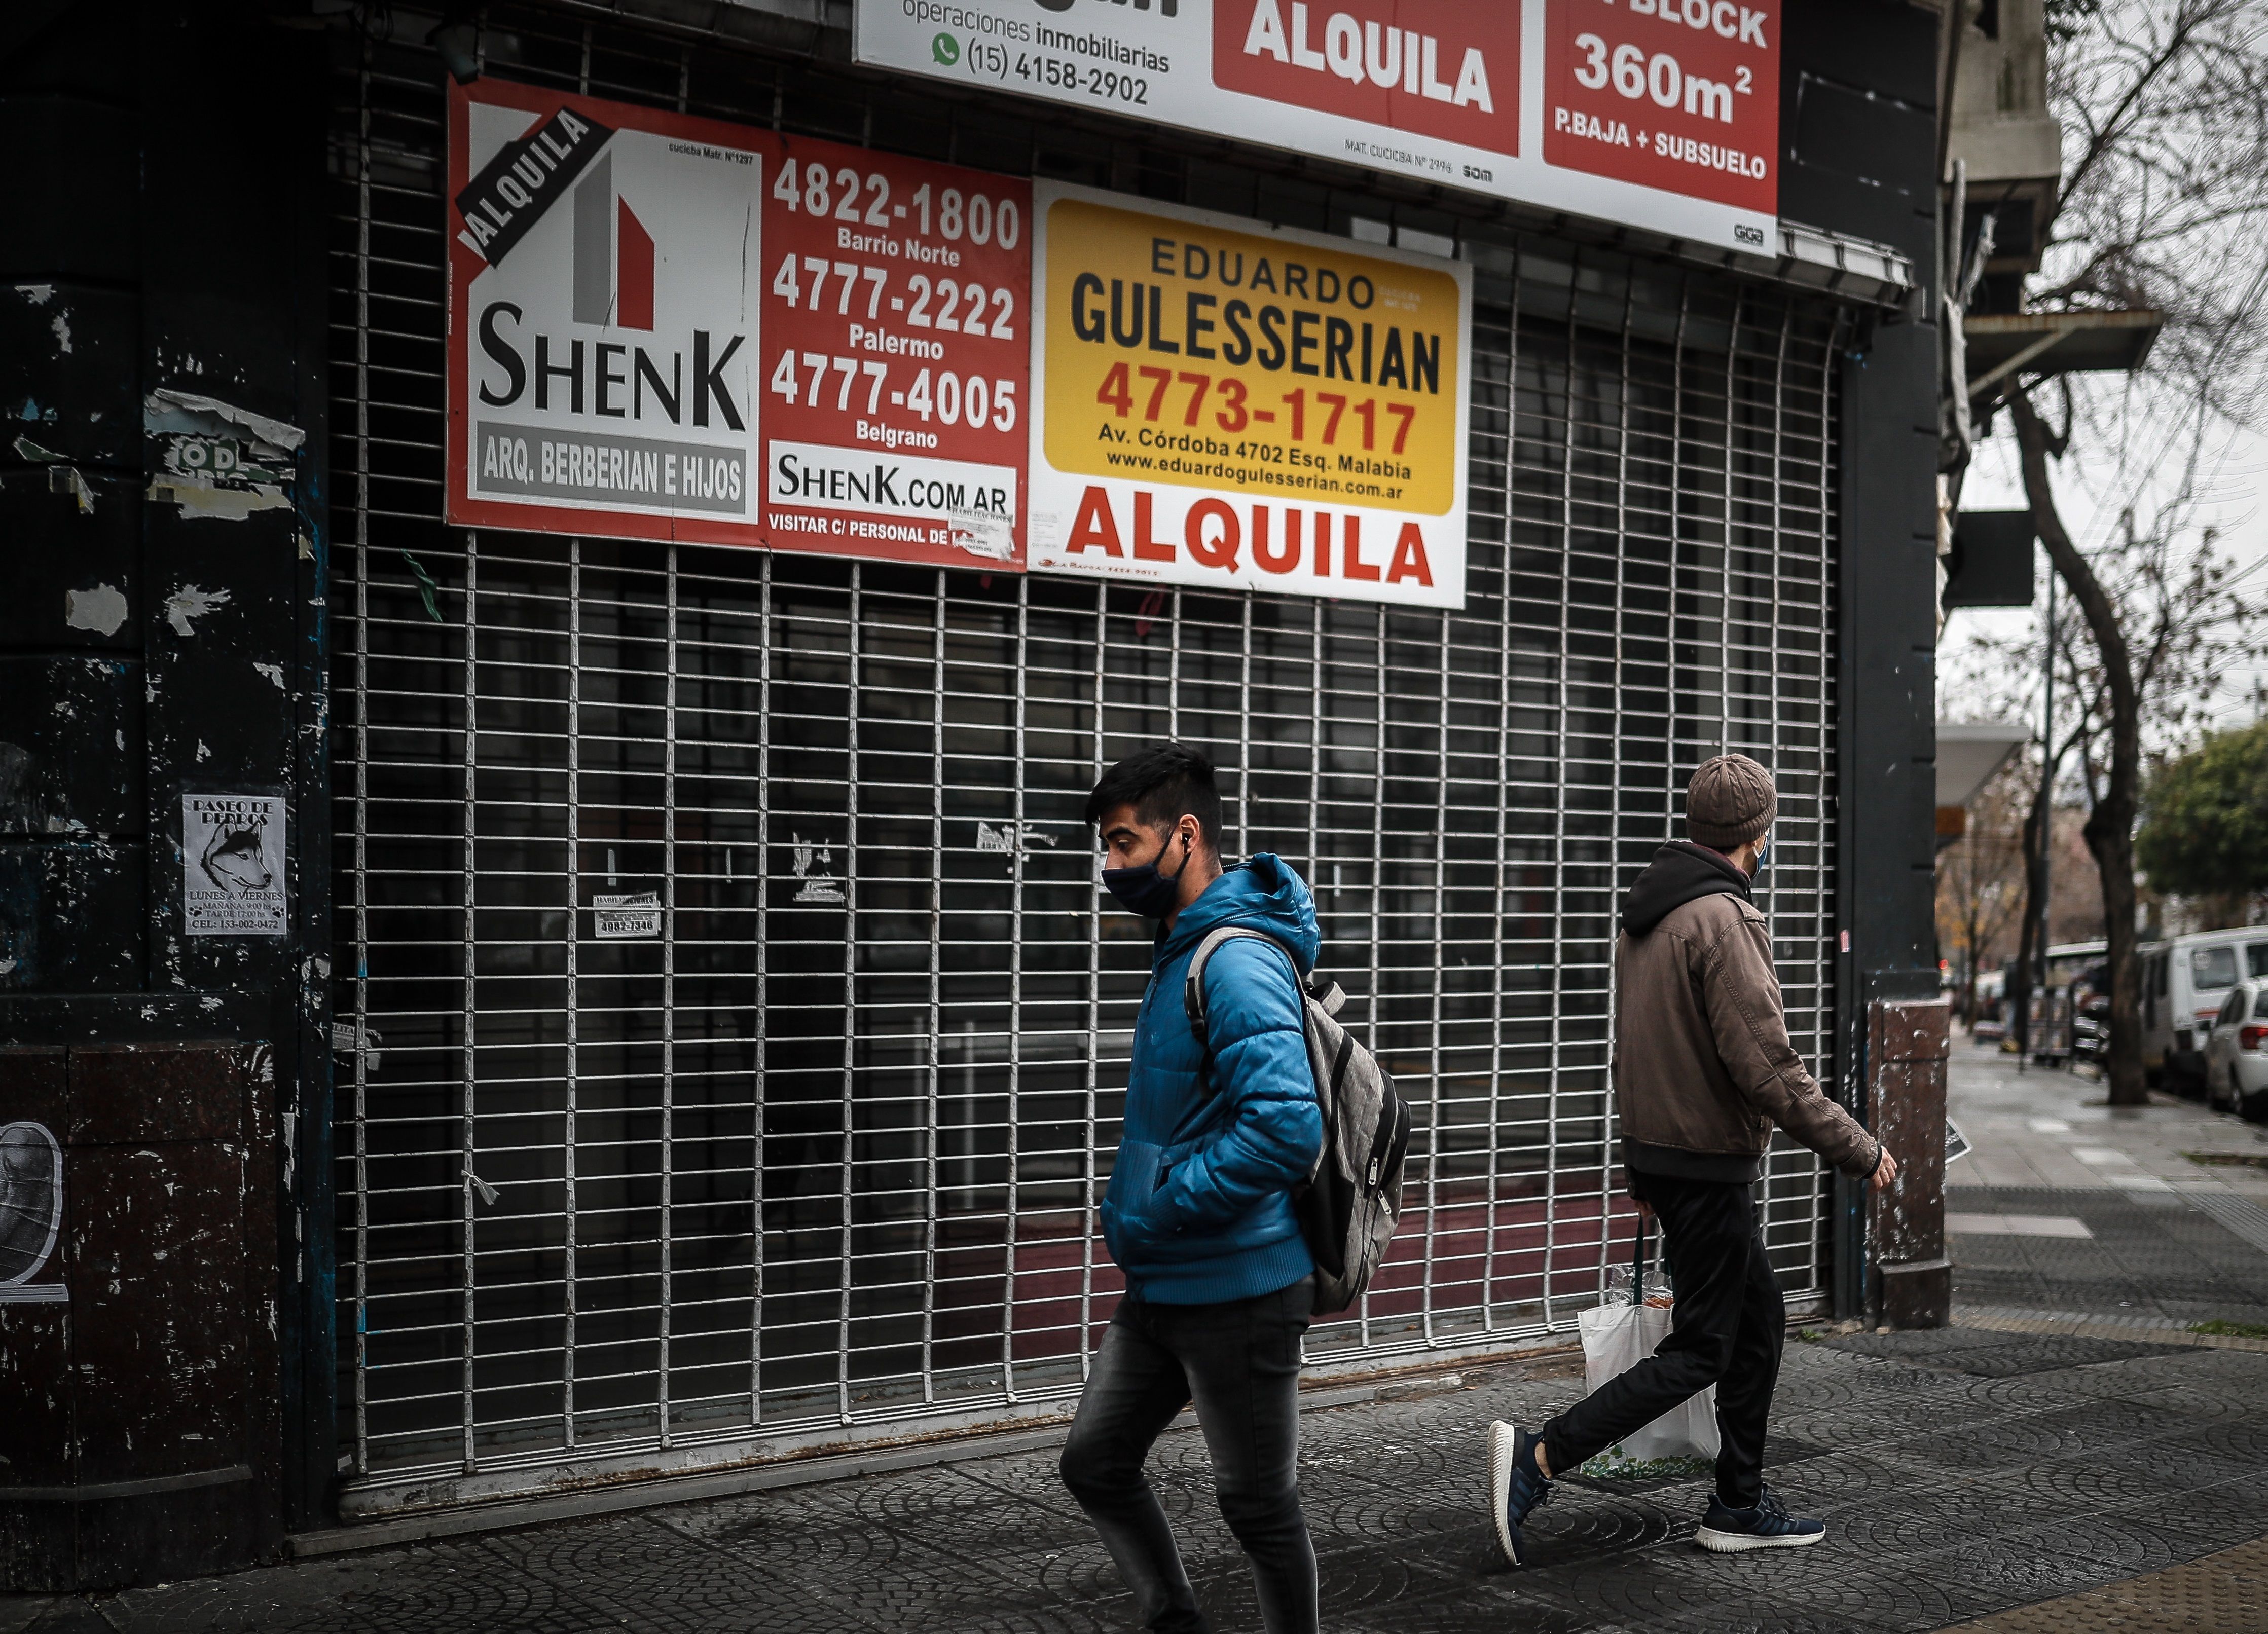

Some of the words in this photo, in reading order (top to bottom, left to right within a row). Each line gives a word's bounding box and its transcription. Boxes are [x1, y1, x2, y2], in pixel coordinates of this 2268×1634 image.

[902, 0, 1030, 42] operaciones
[1036, 22, 1169, 72] inmobiliarias
[1243, 0, 1494, 114] ALQUILA
[968, 38, 1009, 80] (15)
[1015, 53, 1148, 105] 4158-2902
[1369, 145, 1411, 164] CUCICBA
[1555, 106, 1630, 147] P.BAJA
[1655, 132, 1767, 180] SUBSUELO
[465, 109, 589, 247] ALQUILA
[774, 157, 1019, 250] 4822-1800
[837, 227, 898, 257] Barrio
[905, 239, 960, 267] Norte
[1151, 237, 1375, 310] EDUARDO
[773, 252, 1014, 340] 4777-2222
[849, 322, 944, 360] Palermo
[1070, 272, 1441, 396] GULESSERIAN
[771, 348, 1016, 432] 4777-4005
[1096, 361, 1416, 456] 4773-1717
[856, 419, 938, 449] Belgrano
[1098, 423, 1130, 444] Av.
[1138, 428, 1229, 456] Córdoba
[1236, 441, 1283, 464] 4702
[1289, 448, 1332, 473] Esq.
[1338, 455, 1411, 480] Malabia
[483, 435, 534, 485] ARQ.
[541, 440, 657, 494] BERBERIAN
[665, 453, 676, 495] E
[683, 455, 741, 502] HIJOS
[1106, 453, 1403, 499] www.eduardogulesserian.com.ar
[768, 512, 828, 535] VISITAR
[831, 518, 846, 536] C/
[850, 519, 926, 544] PERSONAL
[929, 528, 947, 545] DE
[1065, 485, 1434, 589] ALQUILA
[193, 800, 247, 812] PASEO
[251, 801, 274, 814] DE
[202, 812, 269, 826] PERROS
[189, 891, 225, 901] LUNES
[227, 892, 236, 901] A
[238, 891, 284, 901] VIERNES
[192, 920, 217, 929] CEL:
